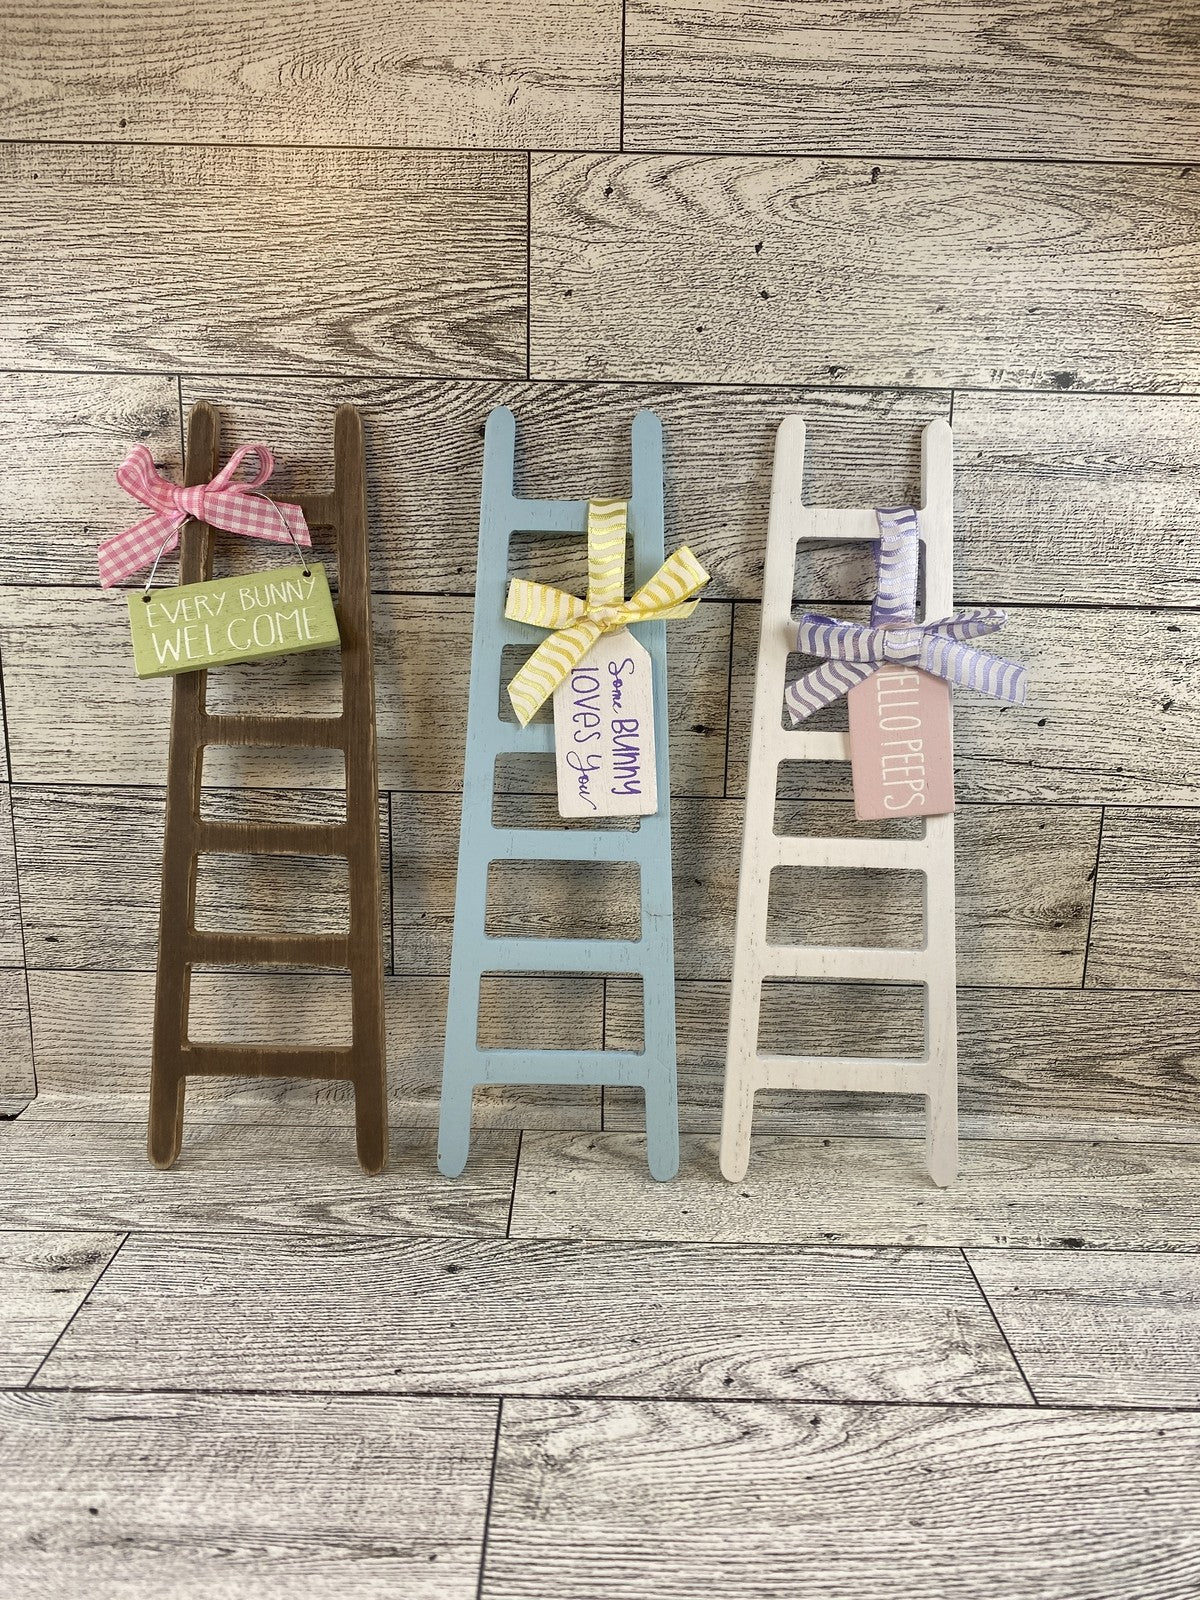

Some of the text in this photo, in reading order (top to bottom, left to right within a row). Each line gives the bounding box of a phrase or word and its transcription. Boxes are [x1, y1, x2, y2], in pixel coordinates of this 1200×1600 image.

[146, 577, 316, 628] EVERY BUNNY
[151, 606, 322, 664] WELCOME
[608, 657, 635, 714] Some
[881, 738, 925, 811] PEEPS
